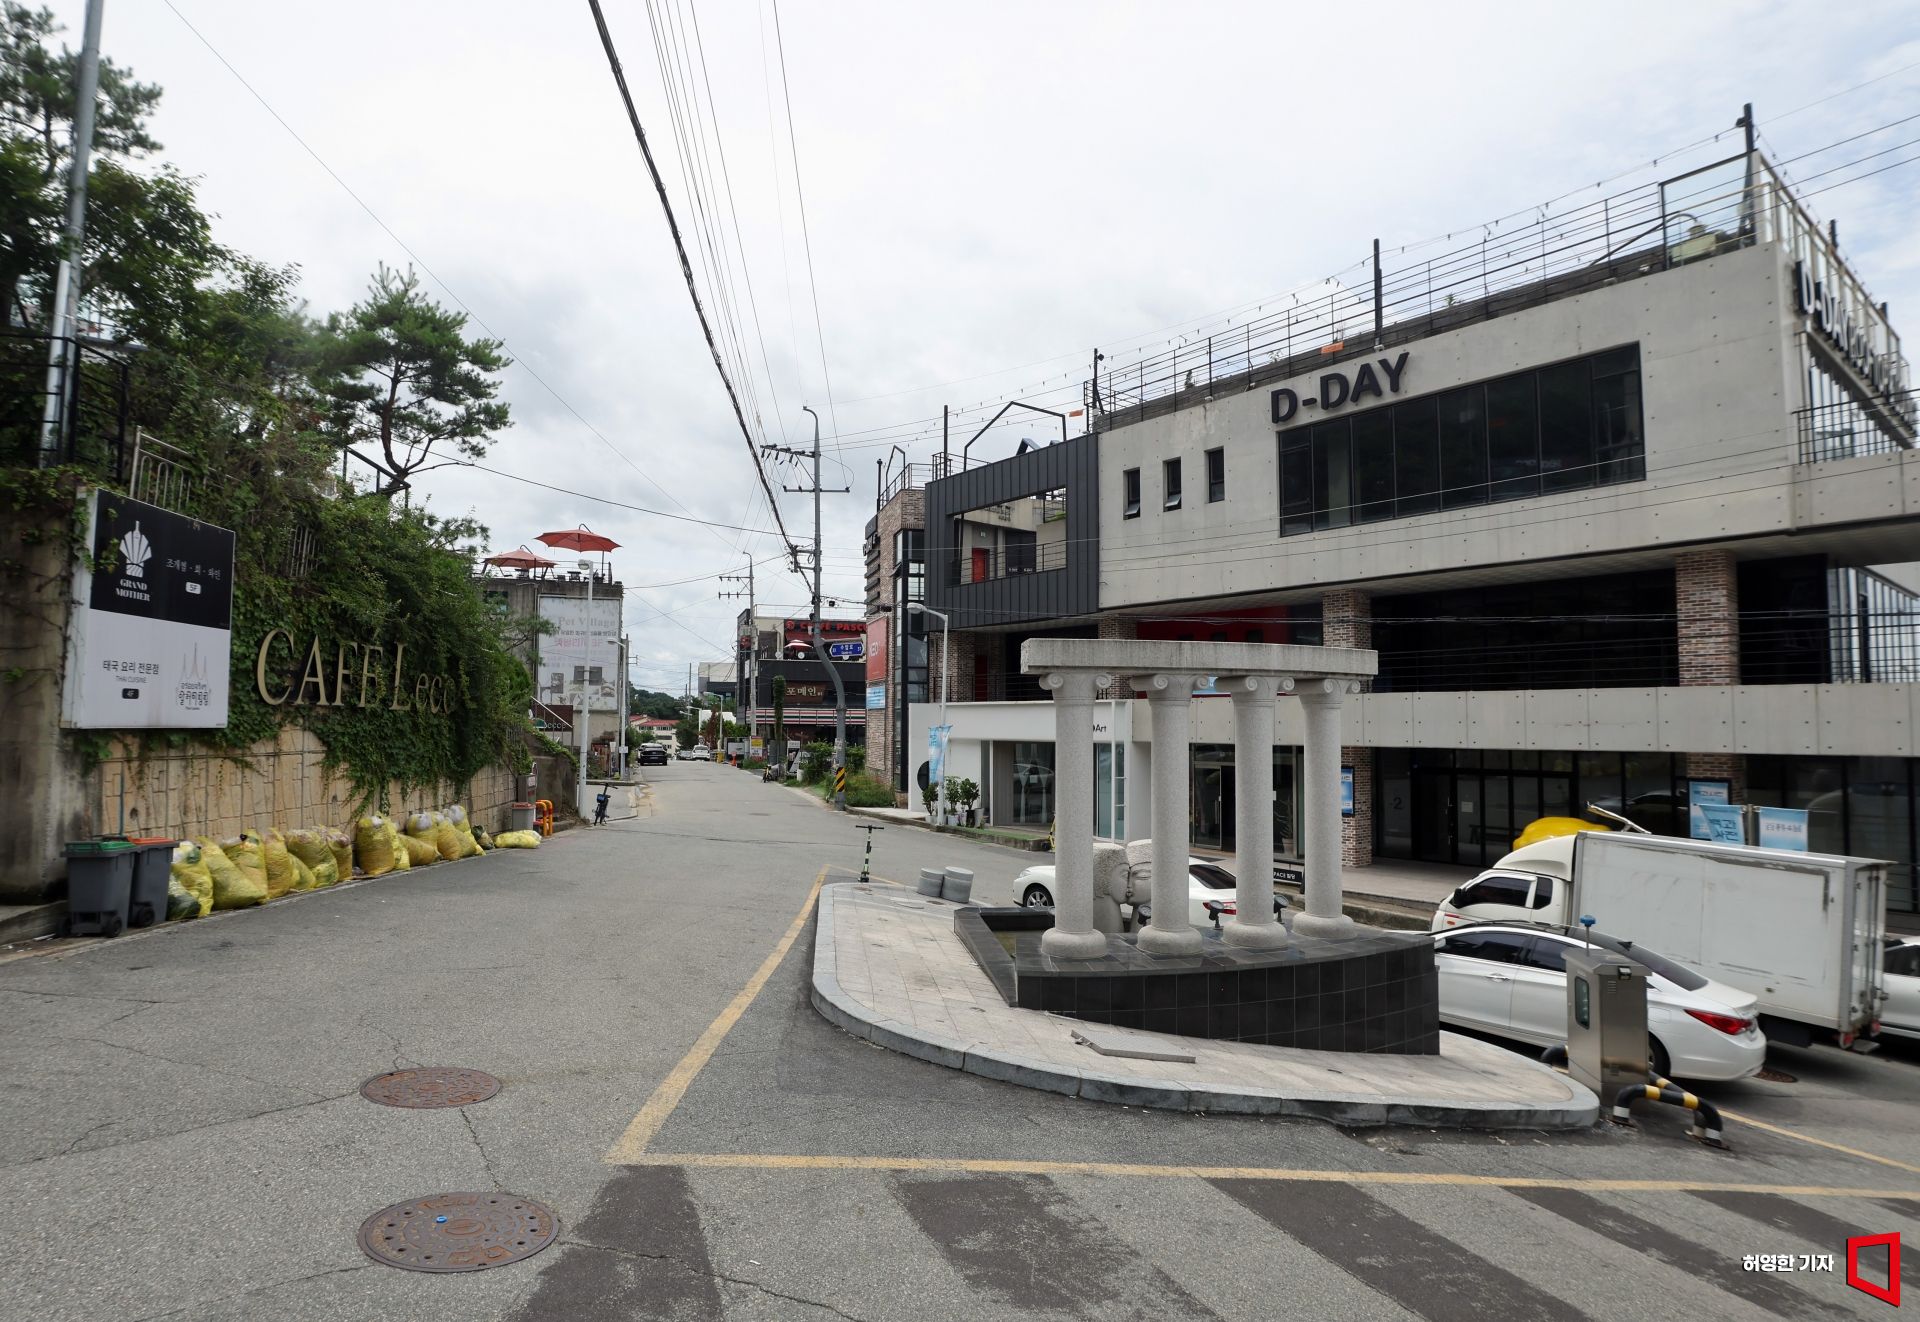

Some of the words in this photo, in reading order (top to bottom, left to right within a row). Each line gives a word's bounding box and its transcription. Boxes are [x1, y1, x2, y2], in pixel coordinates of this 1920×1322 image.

[1271, 352, 1410, 424] D-DAY
[119, 579, 148, 592] GRAND
[115, 588, 151, 602] MOTHER
[578, 617, 616, 628] Vllage
[103, 660, 119, 672] 태국
[121, 661, 136, 673] 요리
[138, 663, 159, 675] 전문점
[257, 628, 383, 708] CAFE
[786, 686, 817, 697] 포메인
